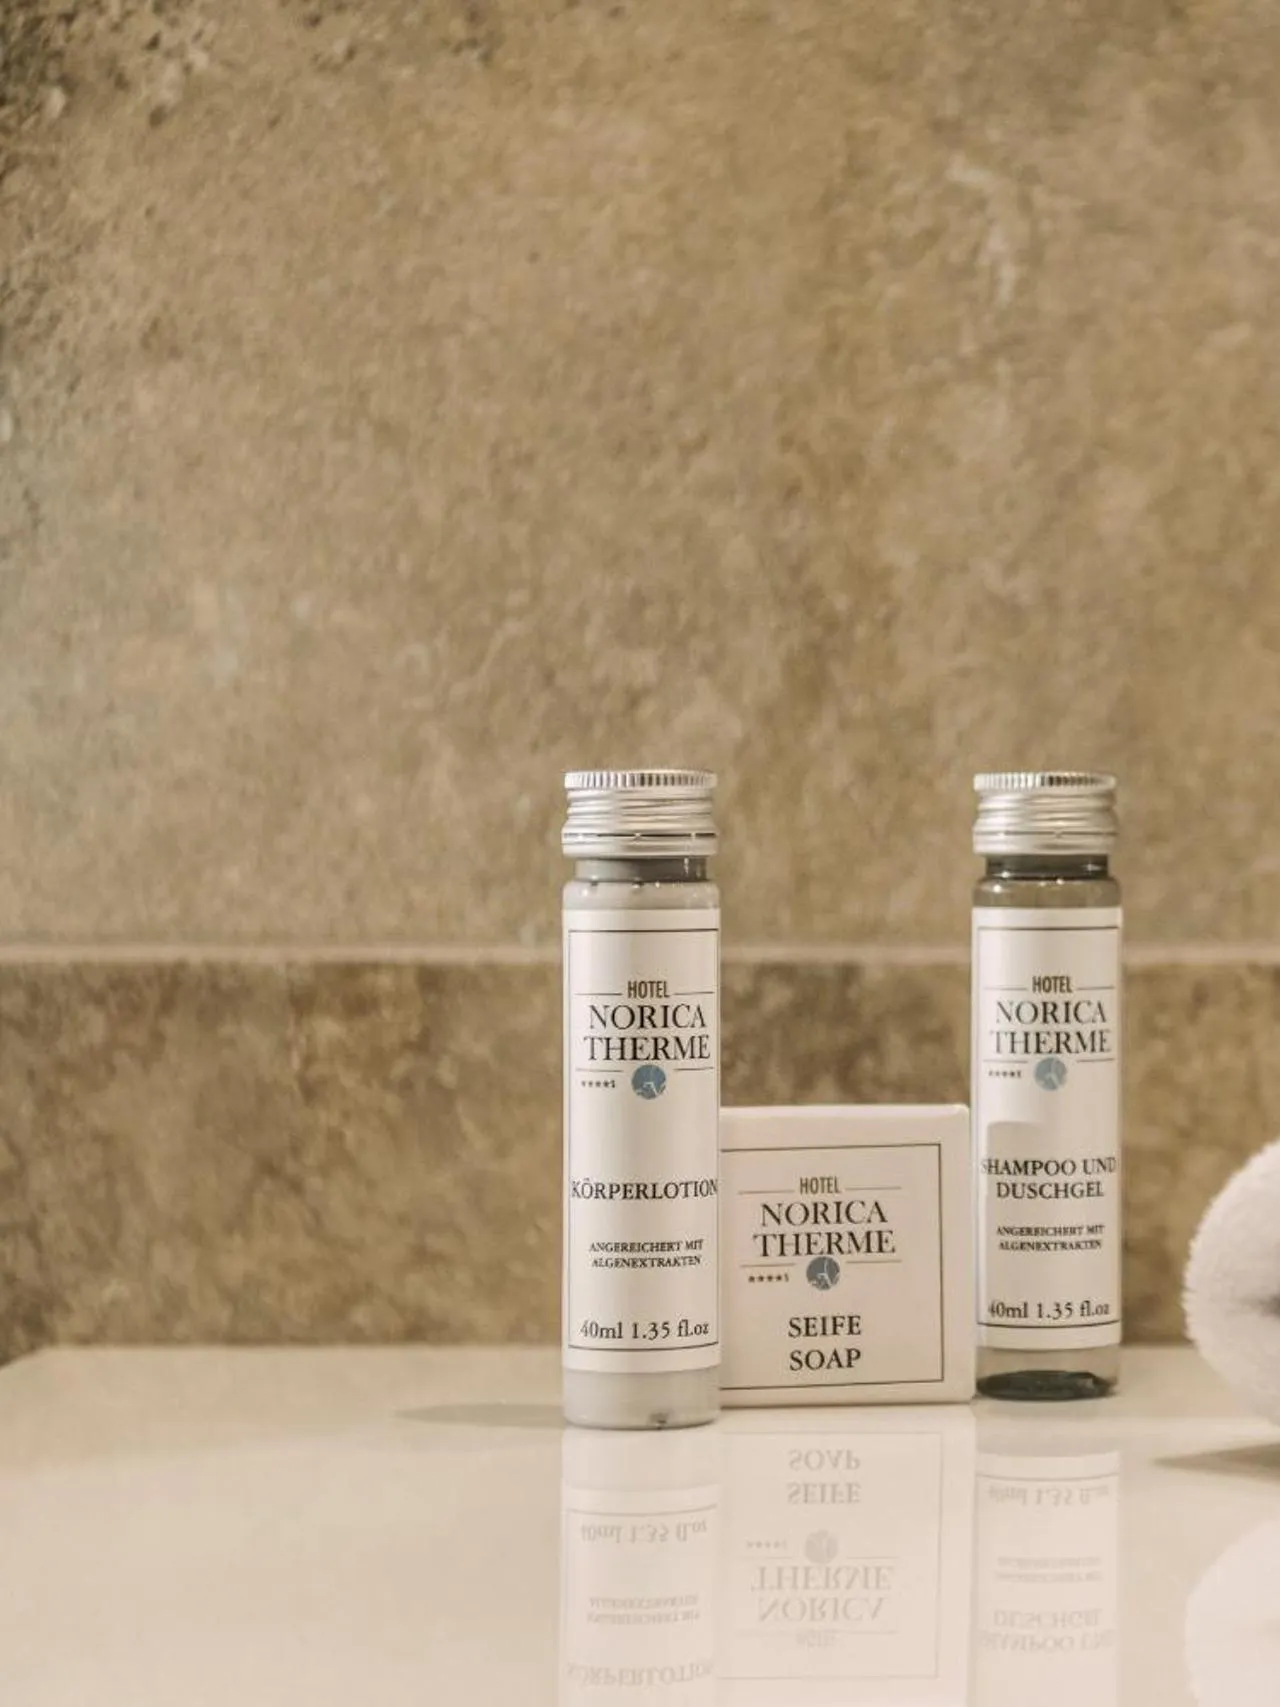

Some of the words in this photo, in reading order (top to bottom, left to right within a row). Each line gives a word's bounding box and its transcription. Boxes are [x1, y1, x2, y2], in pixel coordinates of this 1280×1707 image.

[627, 980, 670, 998] HOTEL
[1032, 975, 1073, 993] HOTEL
[588, 1004, 706, 1030] NORICA
[996, 1001, 1107, 1024] NORICA
[584, 1034, 711, 1061] THERME
[990, 1029, 1112, 1054] THERME
[981, 1159, 1077, 1176] SHAMPOO
[1083, 1157, 1117, 1175] UND
[571, 1178, 719, 1200] KÖRPERLOTION
[800, 1176, 841, 1194] HOTEL
[996, 1181, 1104, 1199] DUSCHGEL
[760, 1200, 888, 1226] NORICA
[996, 1226, 1084, 1236] ANGEREICHERT
[1086, 1225, 1104, 1236] MIT
[590, 1241, 683, 1252] ANGEREICHERT
[685, 1239, 704, 1251] MIT
[753, 1230, 896, 1257] THERME
[591, 1255, 702, 1268] ALGENEXTRAKTEN
[988, 1301, 1029, 1318] 40ml
[1036, 1302, 1074, 1320] 1.35
[580, 1320, 623, 1339] 40ml
[631, 1321, 670, 1340] 1.35
[677, 1319, 710, 1338] fl.oz
[788, 1315, 862, 1338] SEIFE
[789, 1348, 862, 1371] SOAP
